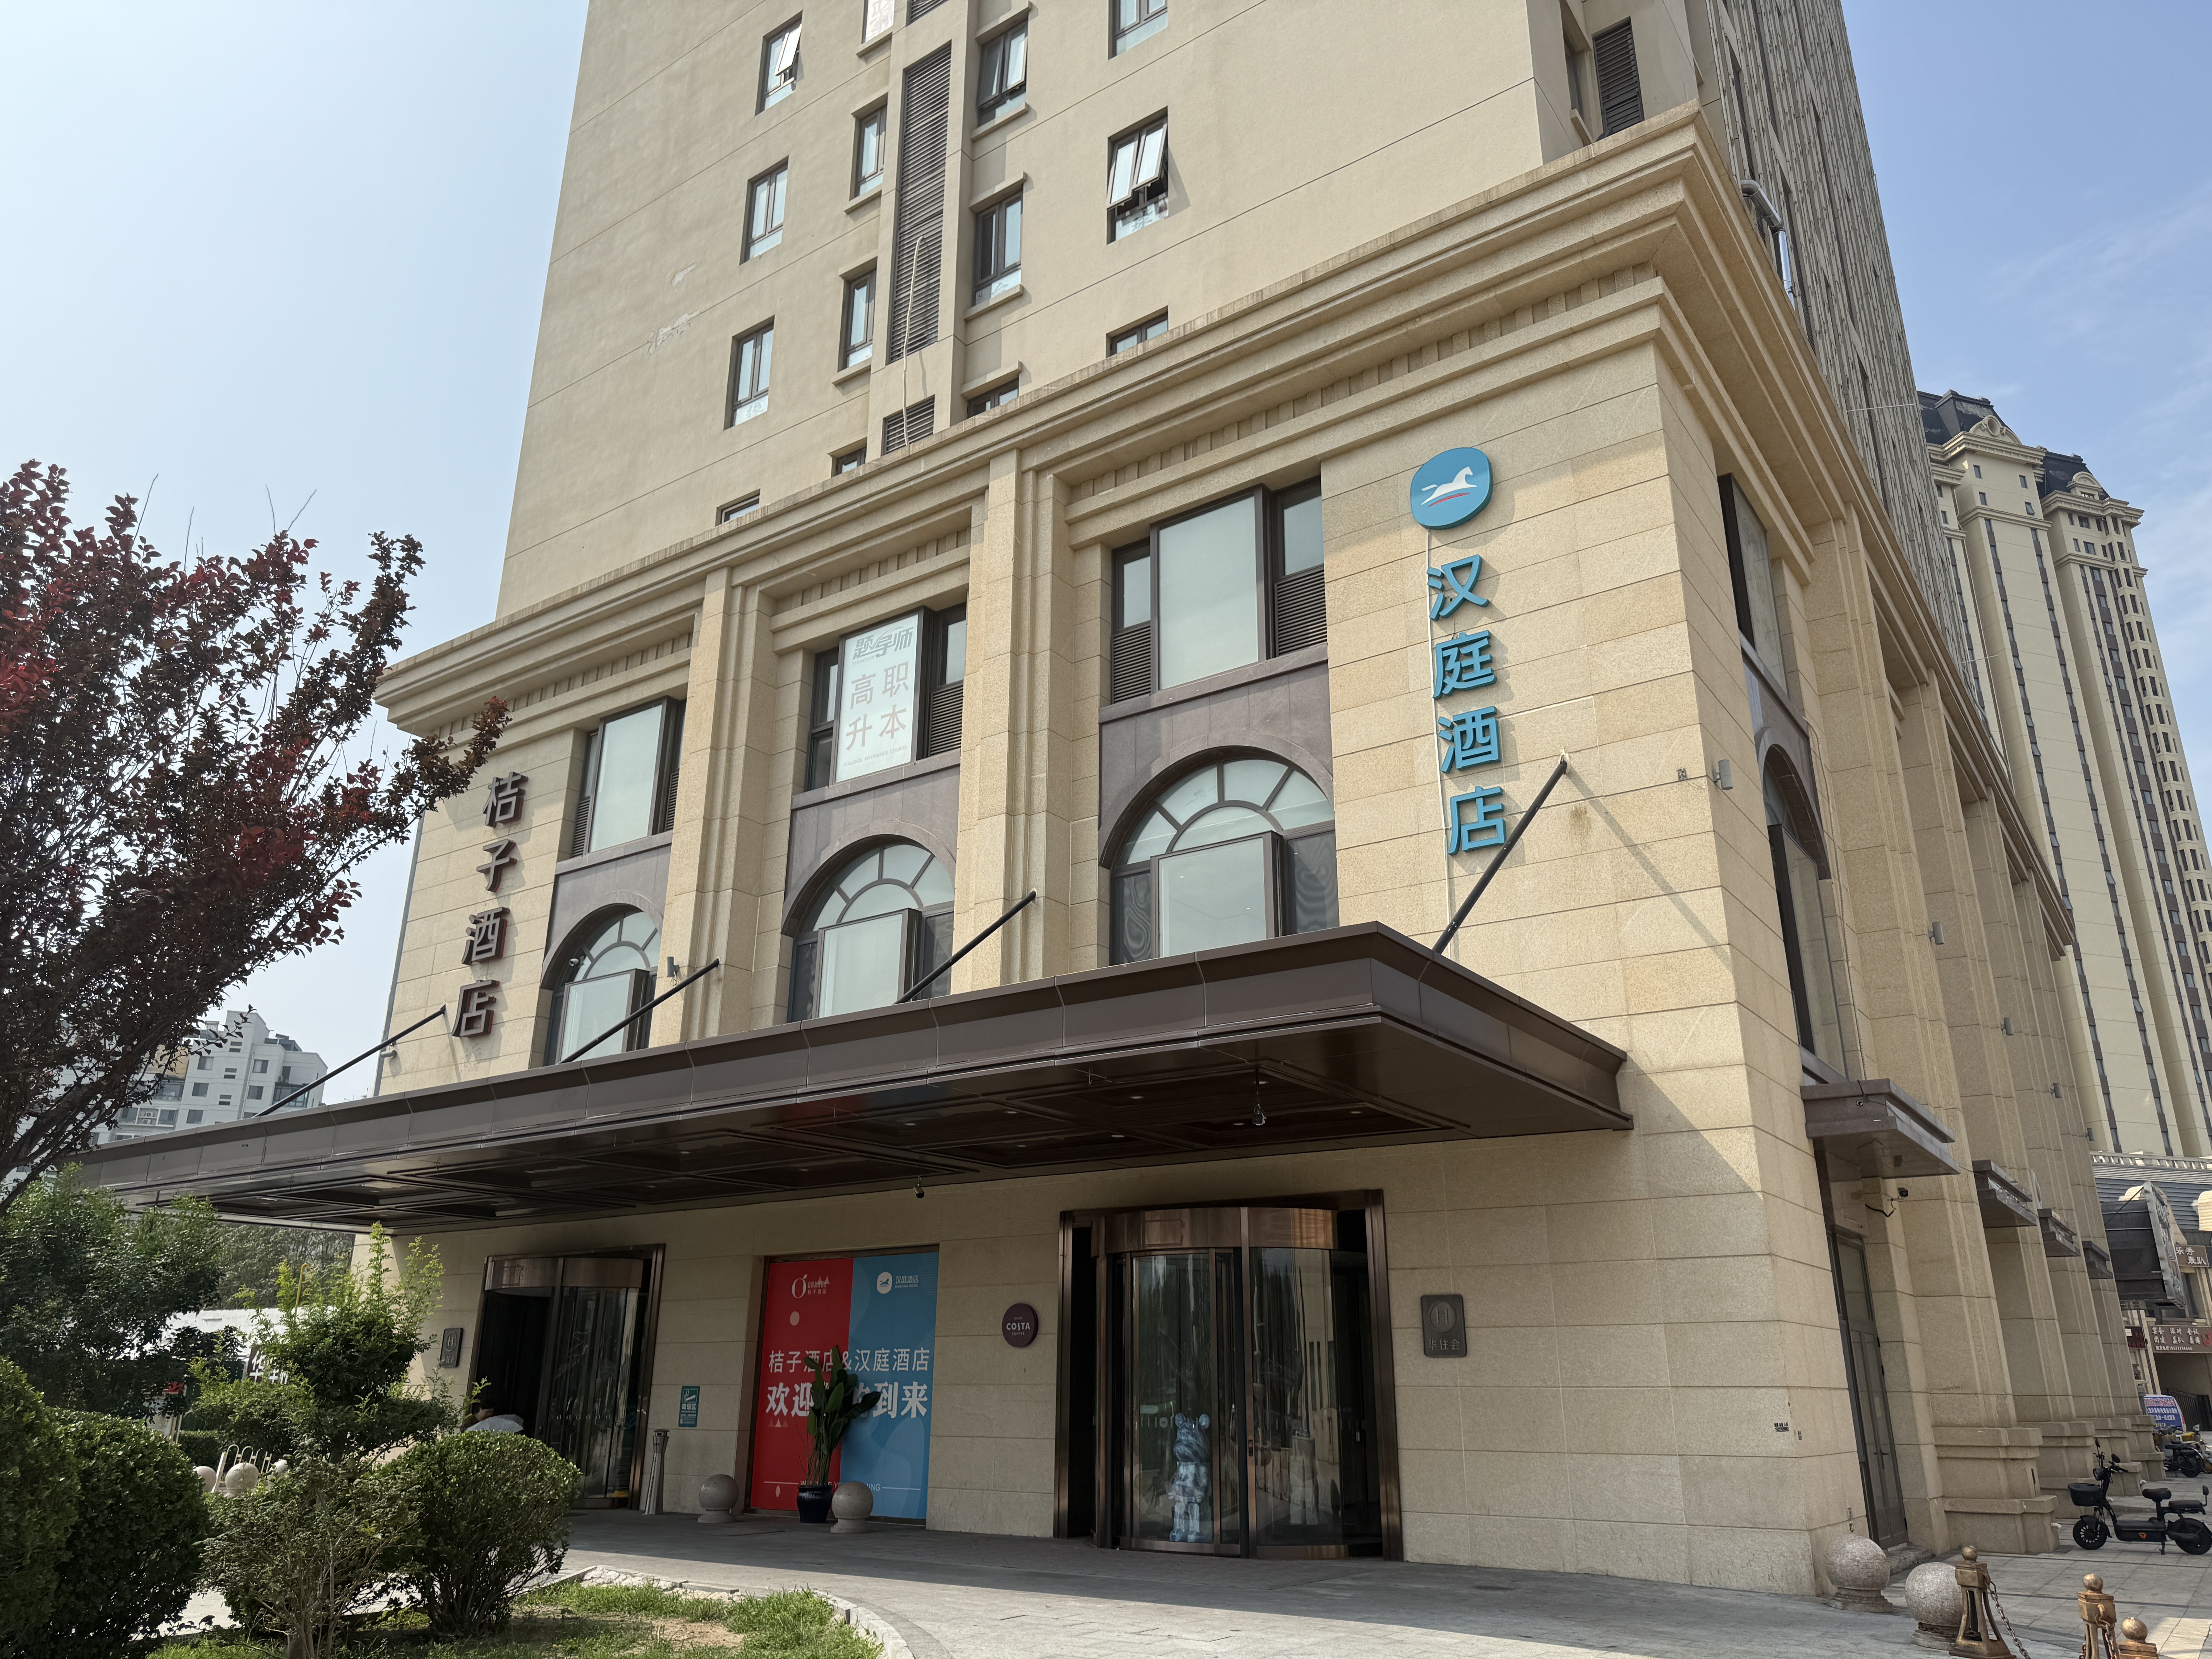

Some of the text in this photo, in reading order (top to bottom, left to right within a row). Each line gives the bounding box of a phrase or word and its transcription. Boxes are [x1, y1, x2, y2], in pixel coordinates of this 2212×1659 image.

[852, 655, 874, 666] TIDAOSHI
[850, 661, 909, 709] 高职
[1427, 555, 1506, 855] 汉庭酒店
[846, 704, 907, 751] 升本
[843, 745, 907, 767] COLLEGE ENTRANCE COURSE
[452, 771, 529, 1037] 桔子酒店
[1006, 1322, 1030, 1331] COSTA
[1429, 1338, 1460, 1350] 华住会
[765, 1381, 928, 1419] 欢迎到来
